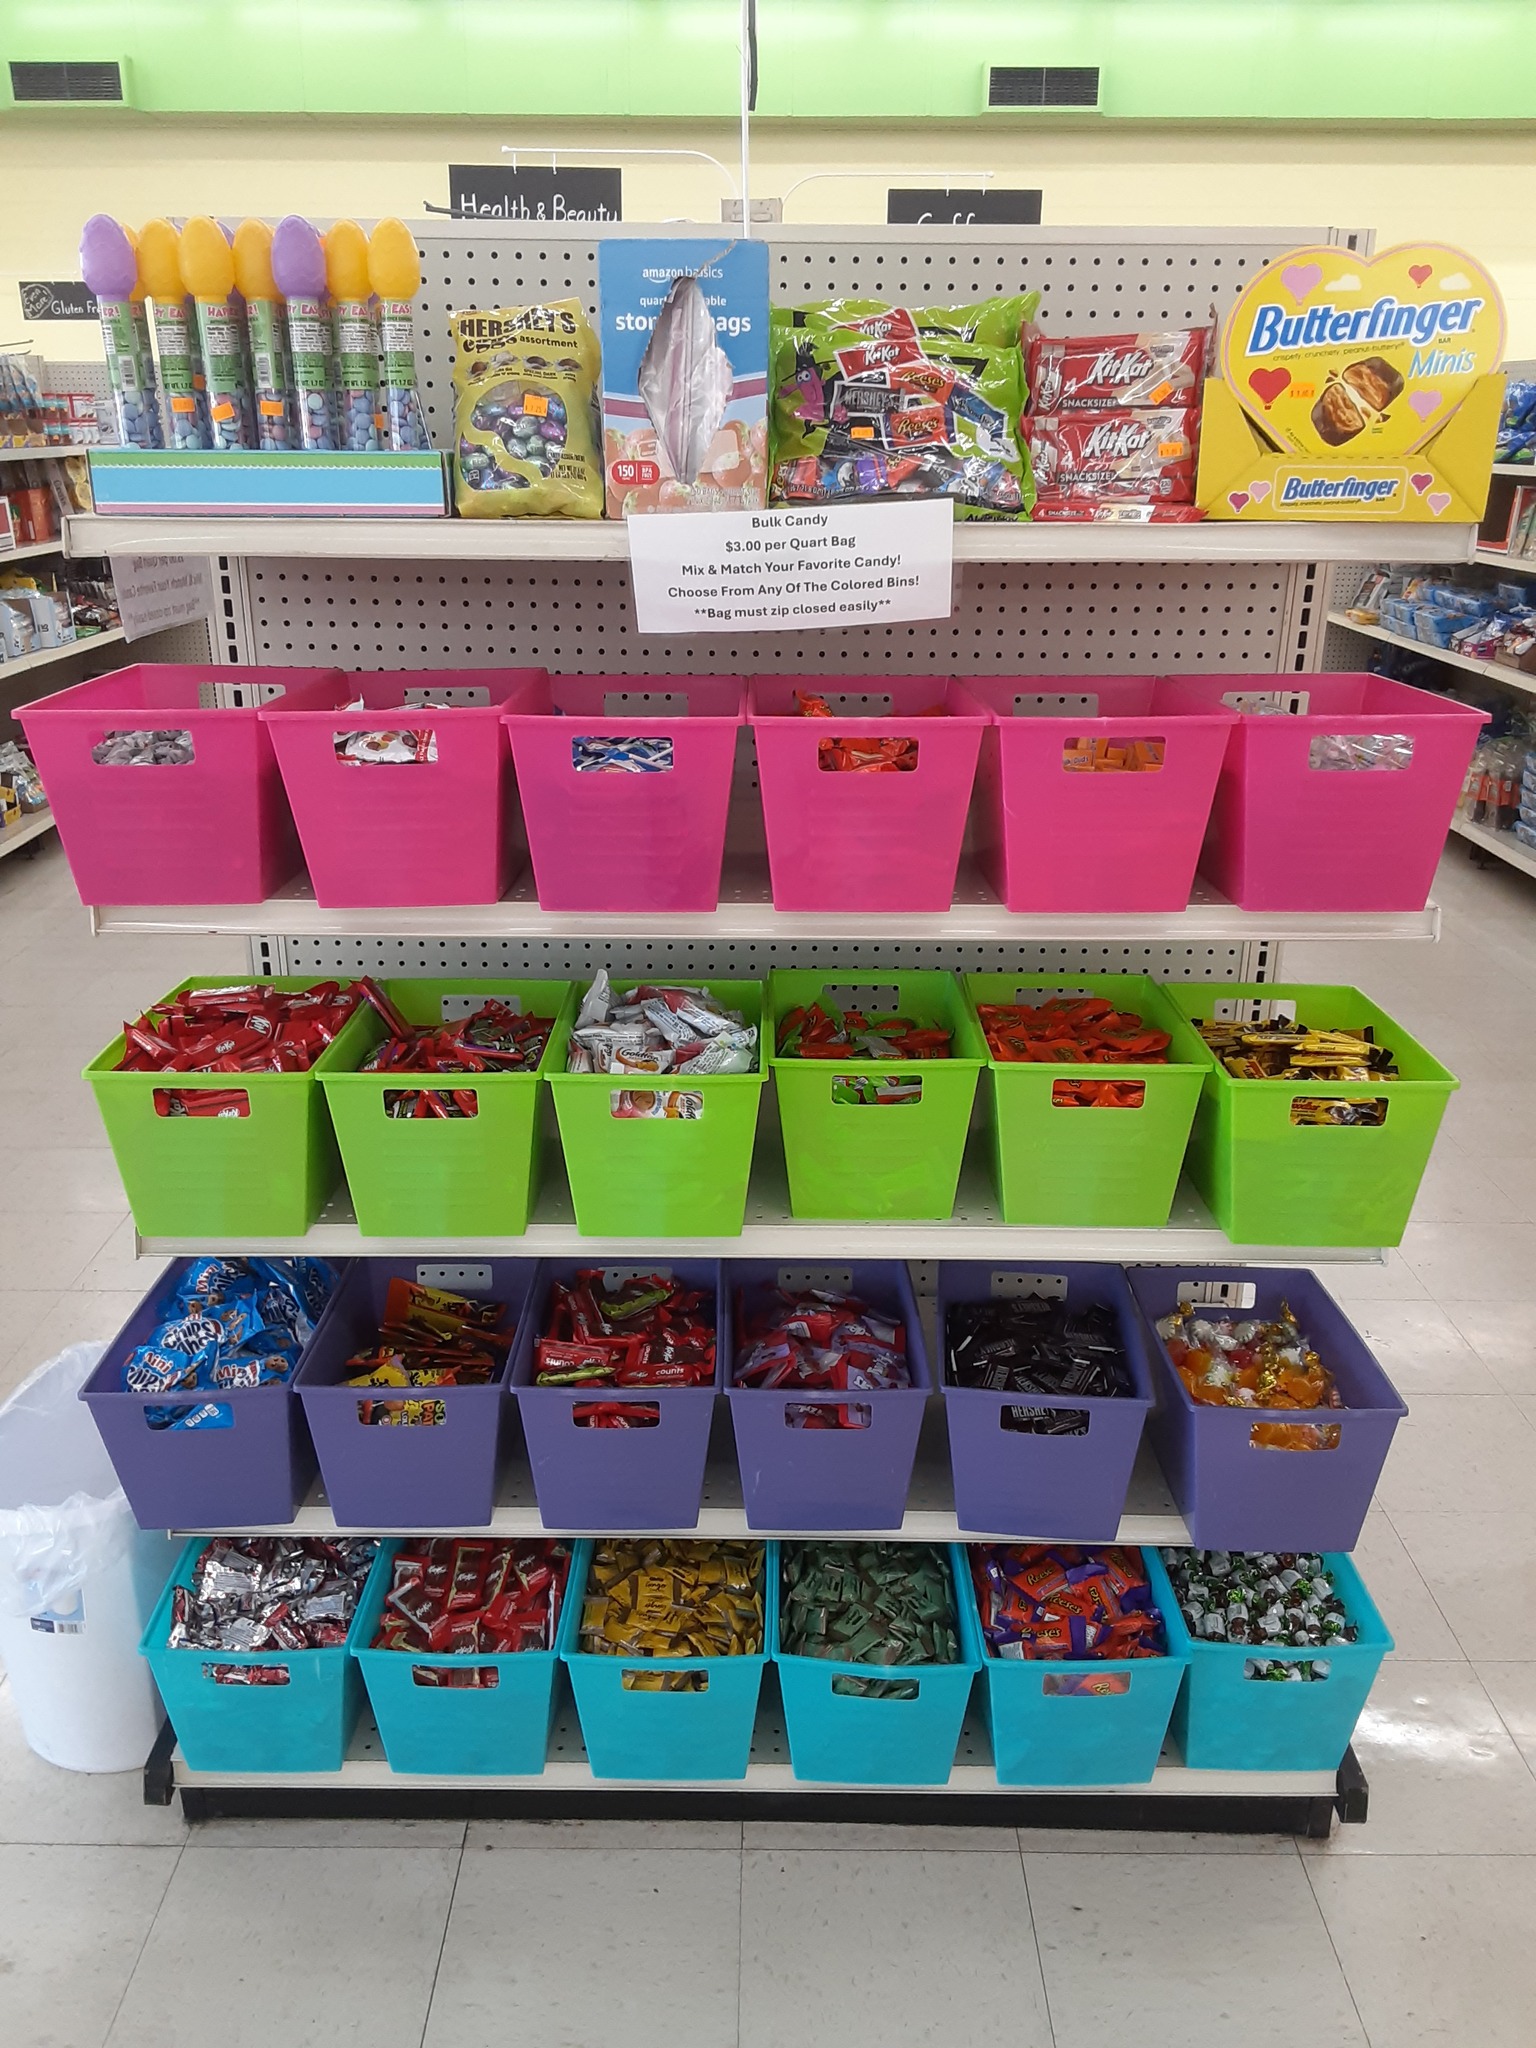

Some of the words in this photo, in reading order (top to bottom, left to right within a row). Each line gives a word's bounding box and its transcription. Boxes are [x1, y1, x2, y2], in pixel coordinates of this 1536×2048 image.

[460, 193, 531, 220] Health
[536, 202, 546, 221] &
[51, 300, 84, 315] Gluten
[615, 313, 657, 332] stor
[1249, 298, 1482, 353] Butterfinger
[519, 335, 578, 349] assortment
[1408, 347, 1476, 378] Minis
[902, 371, 946, 388] Reese's
[897, 418, 939, 434] Reese's
[617, 464, 635, 477] 150
[1282, 477, 1399, 501] Butterfinger
[752, 516, 782, 528] Bulk
[784, 513, 829, 527] Candy
[725, 540, 762, 553] $3.00
[764, 540, 787, 553] per
[789, 536, 828, 551] Quart
[831, 535, 856, 549] Bag
[682, 565, 705, 576] Mix
[707, 564, 717, 575] &
[720, 563, 762, 575] Match
[764, 561, 795, 573] Your
[797, 558, 851, 571] Favorite
[854, 554, 901, 568] Candy!
[668, 587, 718, 598] Choose
[721, 585, 755, 597] From
[757, 584, 783, 597] Any
[785, 582, 801, 594] Of
[803, 581, 828, 593] The
[830, 578, 884, 591] Colored
[887, 575, 920, 588] Bins!
[734, 606, 768, 618] must
[770, 605, 790, 618] zip
[792, 602, 836, 615] closed
[655, 1367, 685, 1376] counts
